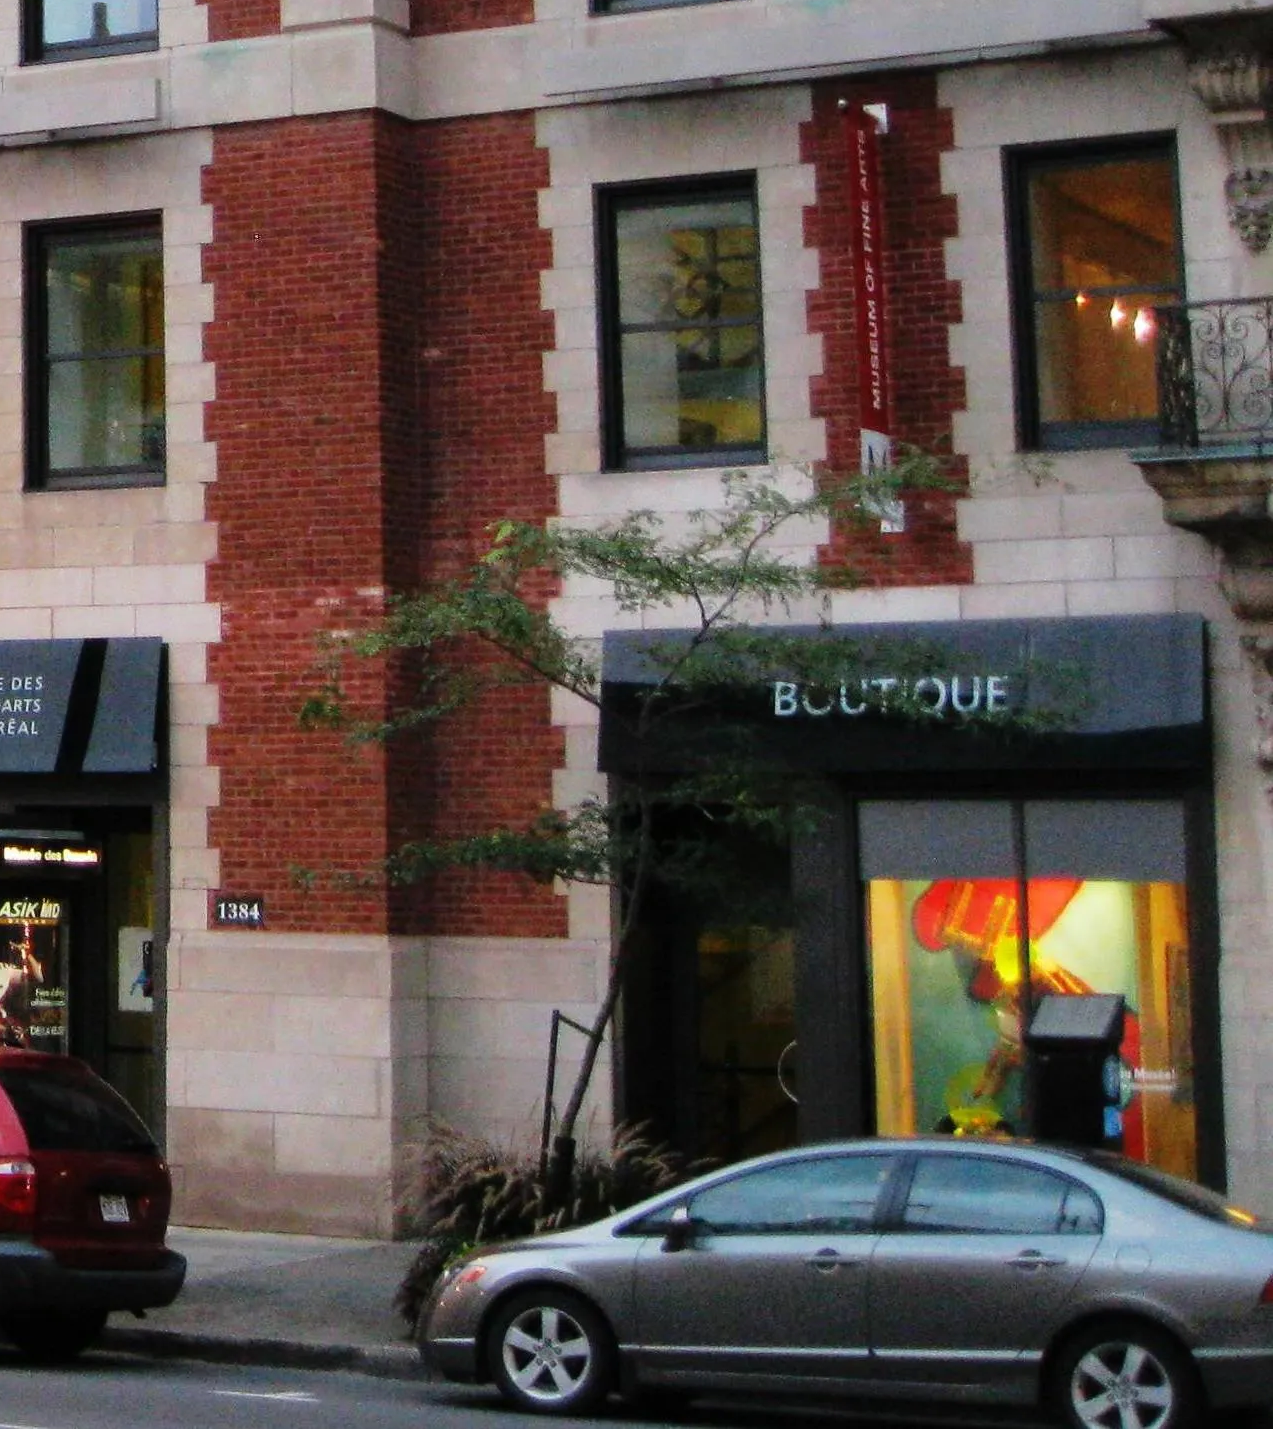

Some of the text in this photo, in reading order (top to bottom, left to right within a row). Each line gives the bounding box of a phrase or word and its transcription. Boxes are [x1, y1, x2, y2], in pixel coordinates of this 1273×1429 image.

[862, 201, 872, 252] FINE
[865, 257, 874, 292] OF
[866, 300, 881, 410] MUSEUM
[11, 676, 43, 691] DES
[218, 902, 260, 920] 1384
